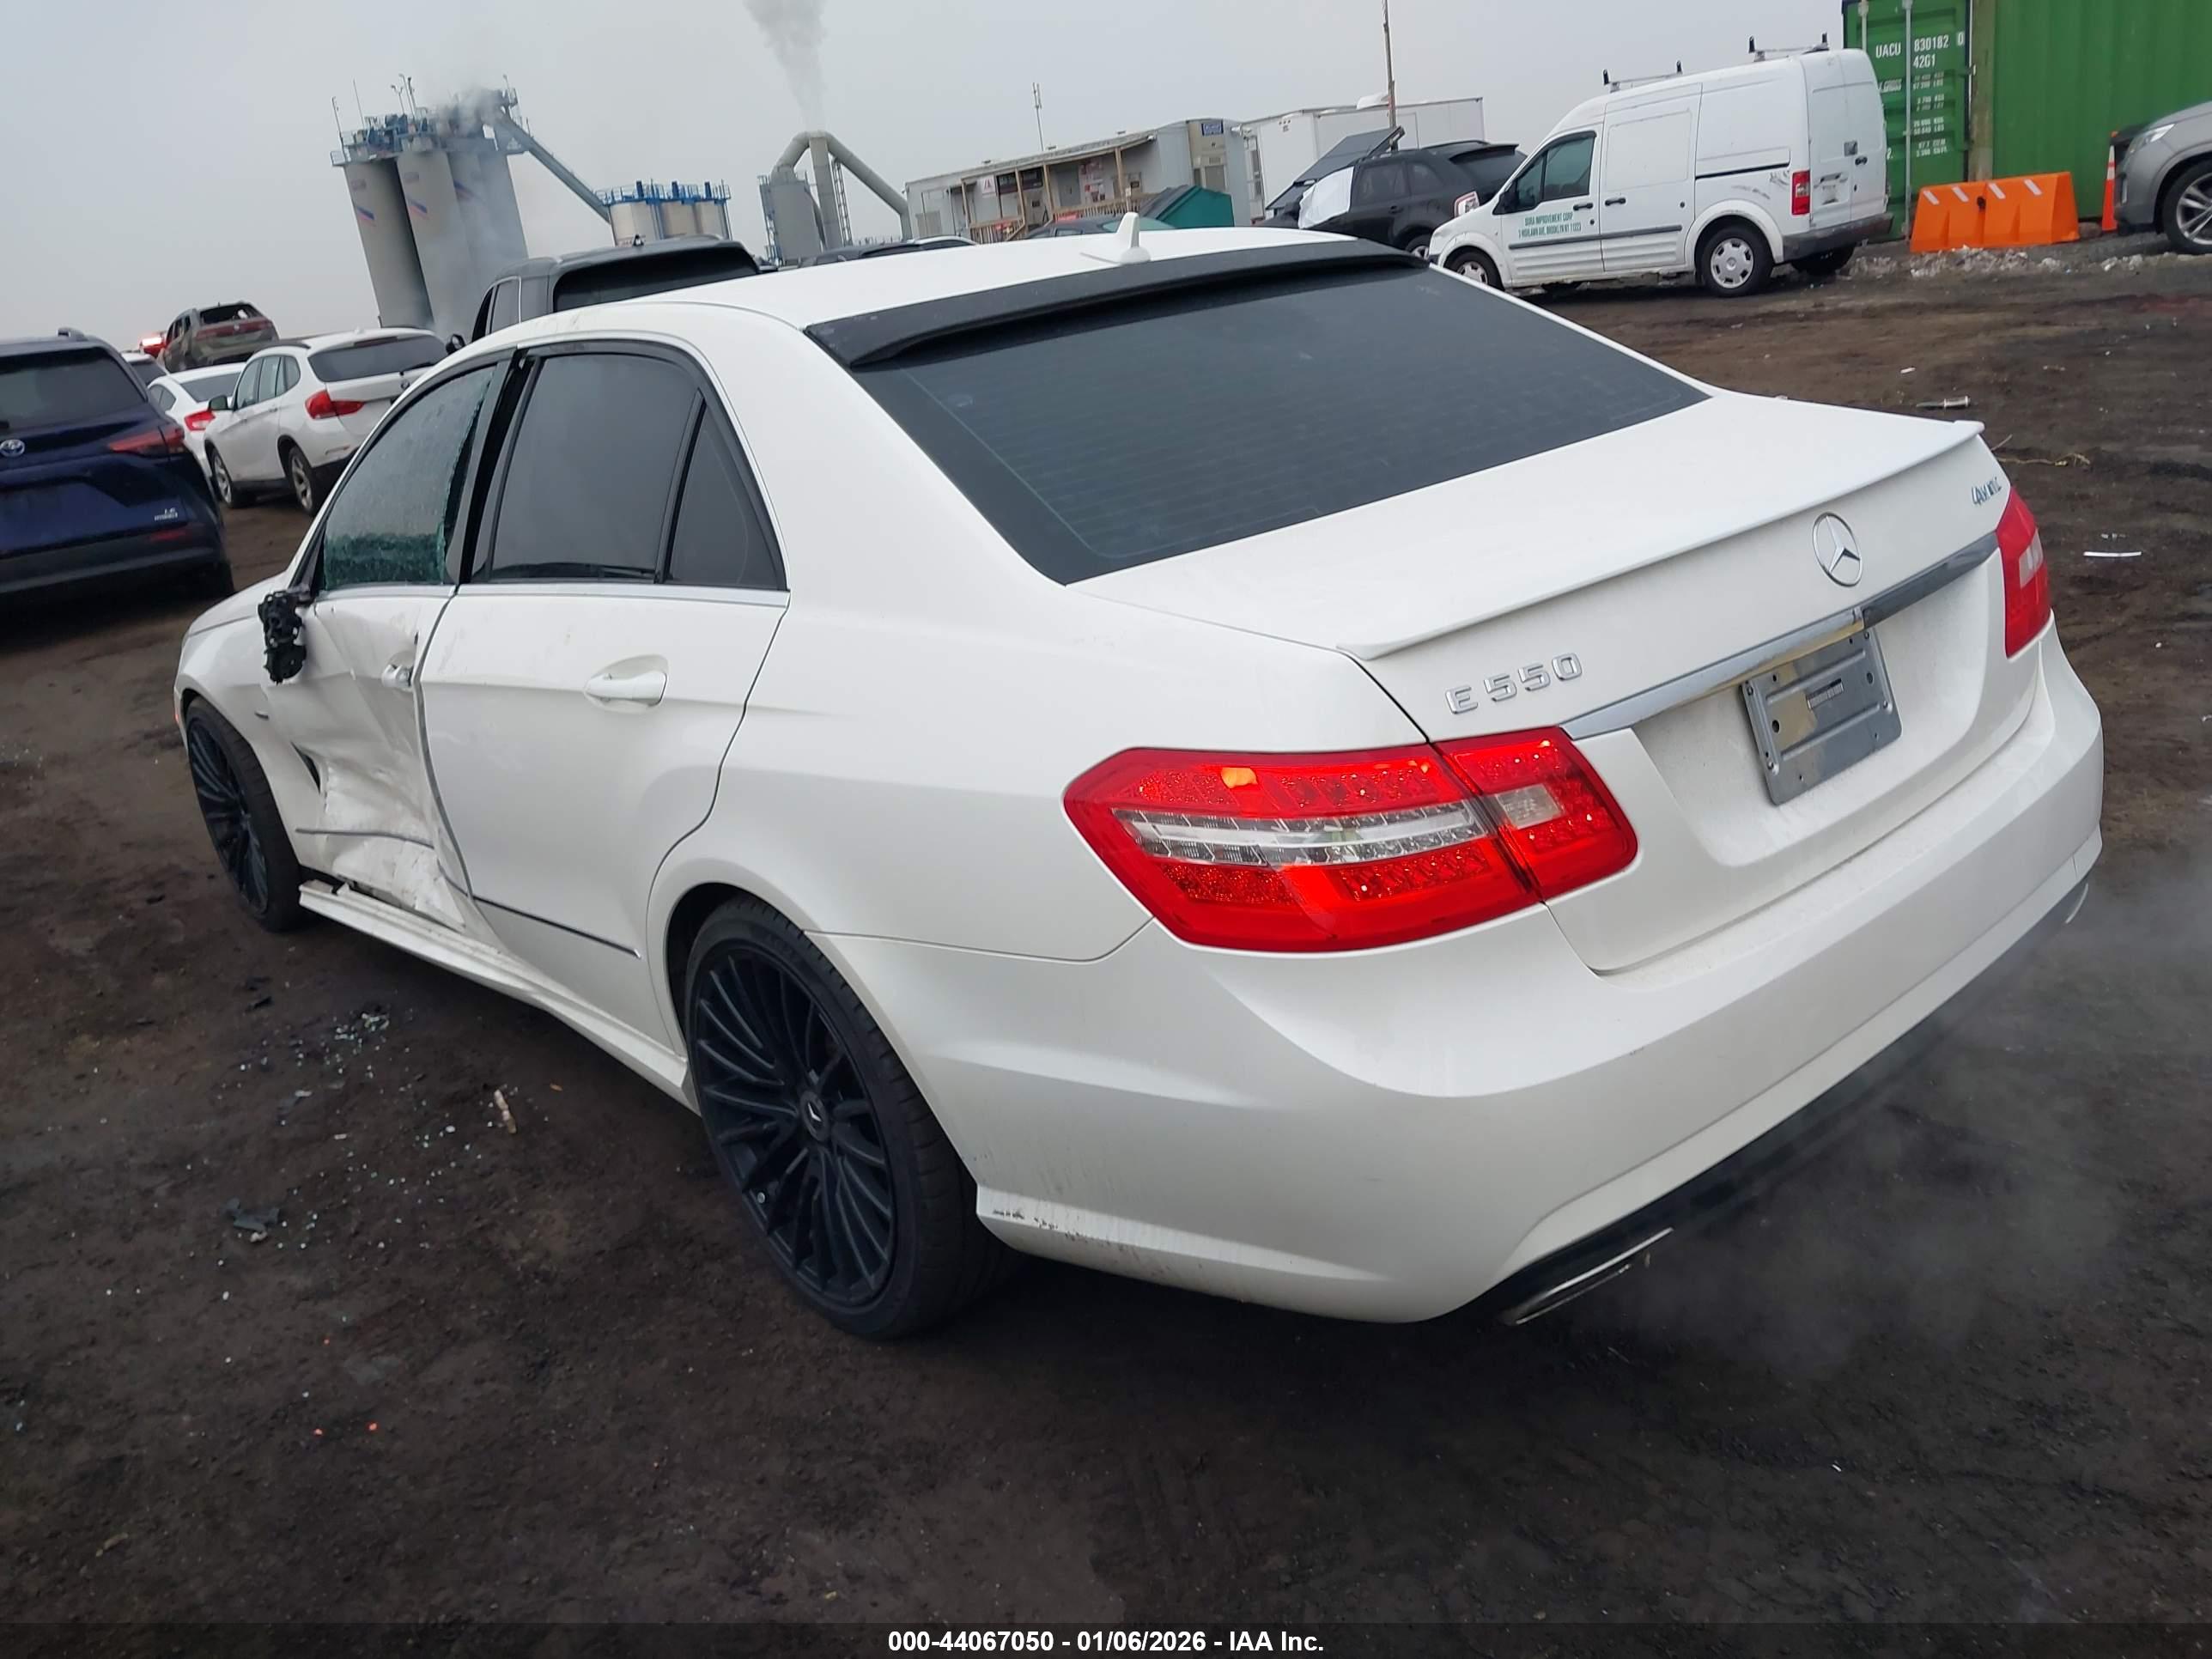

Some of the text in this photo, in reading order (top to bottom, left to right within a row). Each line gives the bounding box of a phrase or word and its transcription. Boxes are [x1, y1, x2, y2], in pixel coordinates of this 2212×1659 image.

[1875, 42, 1901, 58] UACU
[1914, 34, 1949, 52] 830182
[1444, 653, 1583, 714] E 550
